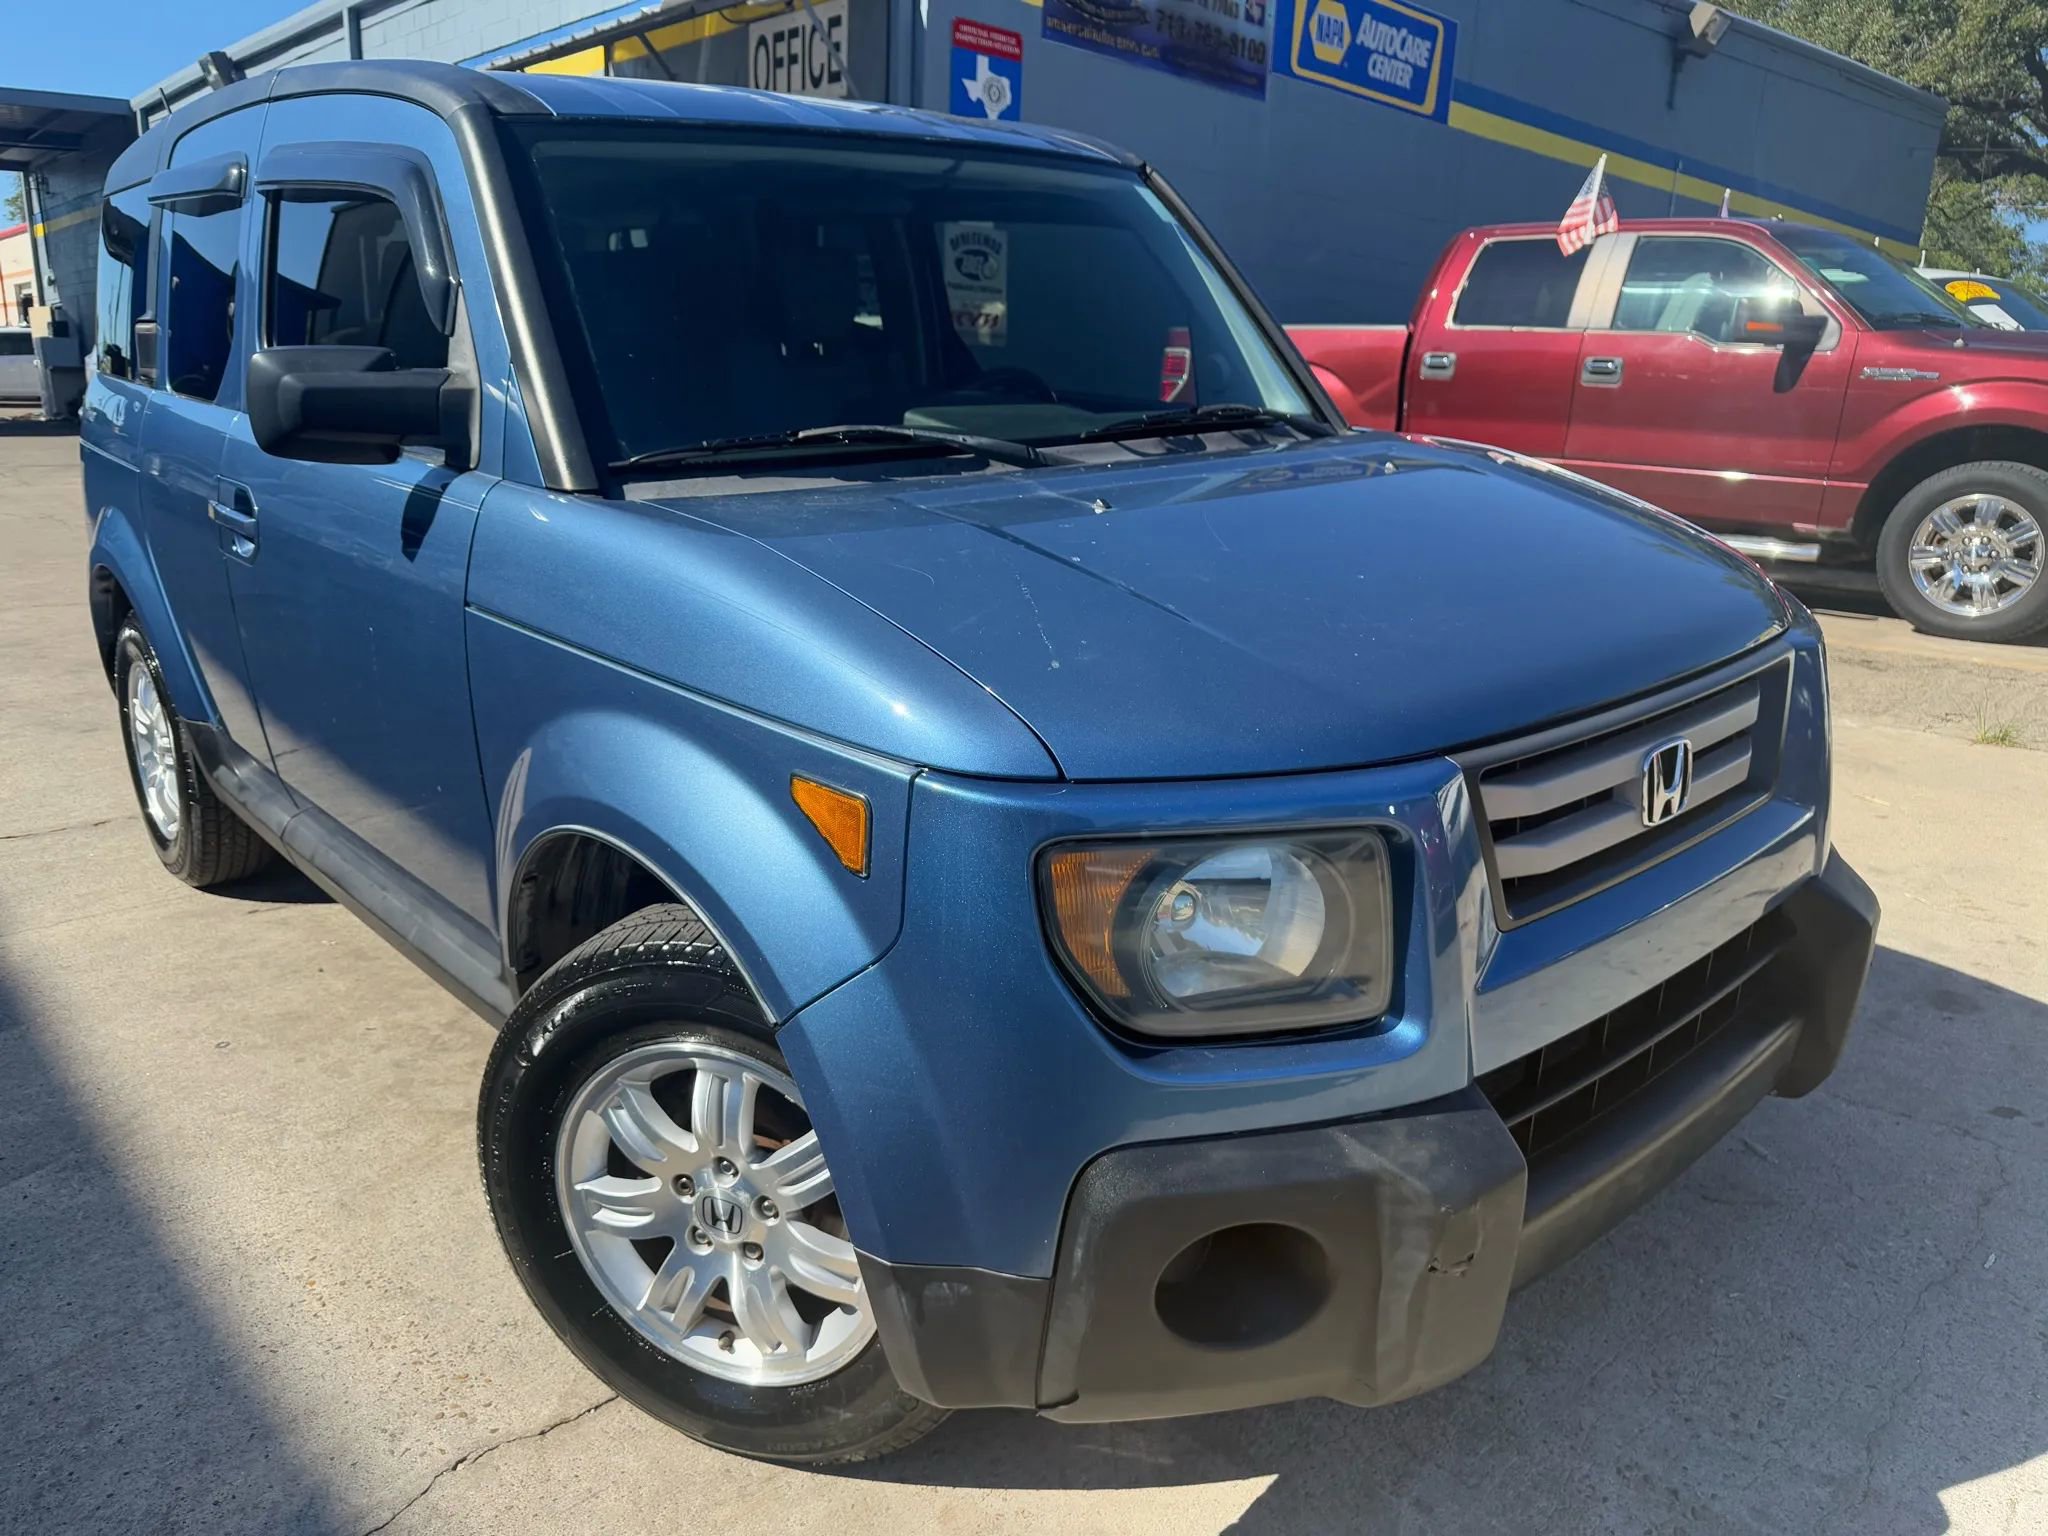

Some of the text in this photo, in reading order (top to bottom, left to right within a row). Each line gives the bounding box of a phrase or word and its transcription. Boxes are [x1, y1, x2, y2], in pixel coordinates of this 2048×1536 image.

[1316, 13, 1345, 49] NAPA
[754, 15, 842, 92] OFFICE
[1367, 53, 1414, 91] CENTER
